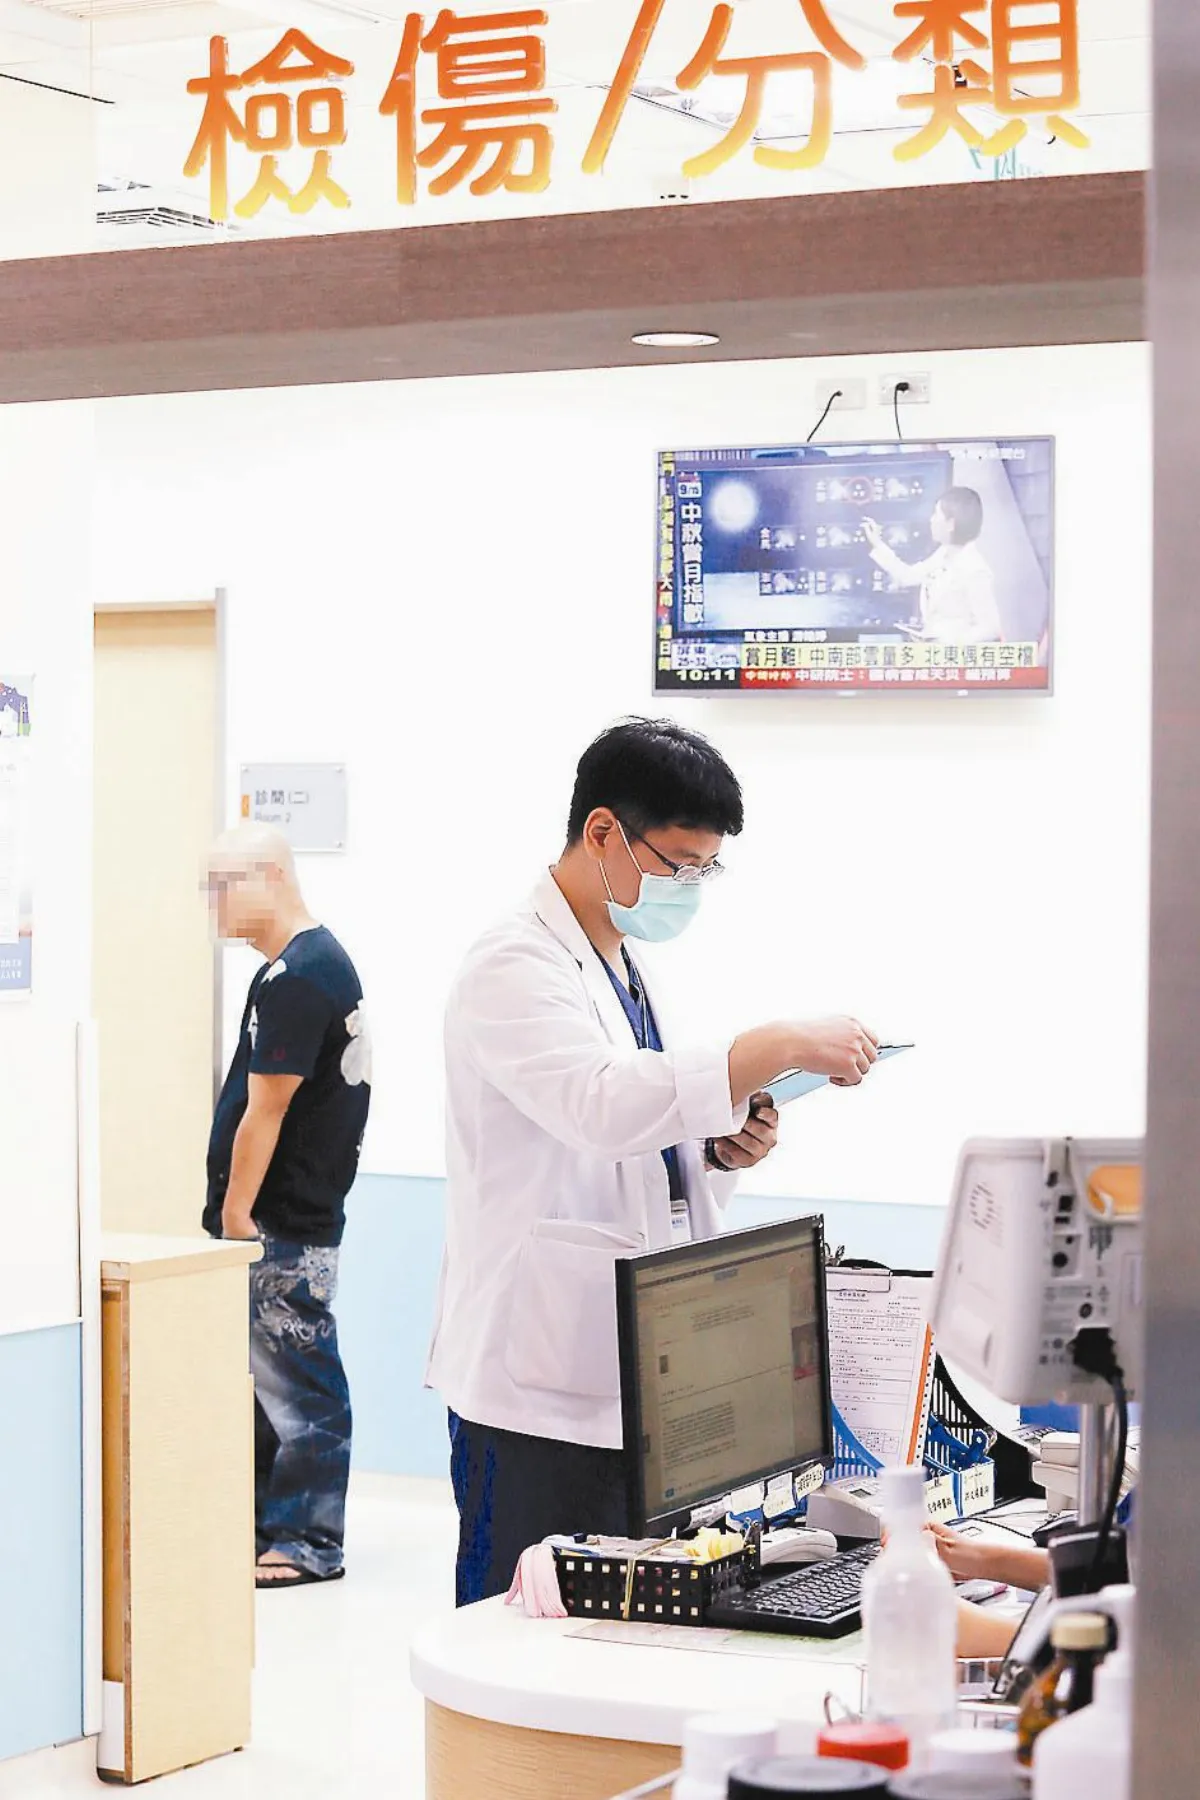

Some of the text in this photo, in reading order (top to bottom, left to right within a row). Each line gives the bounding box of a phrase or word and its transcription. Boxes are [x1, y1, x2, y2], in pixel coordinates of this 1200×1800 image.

[676, 669, 736, 681] 10:11
[254, 812, 292, 824] Room 2
